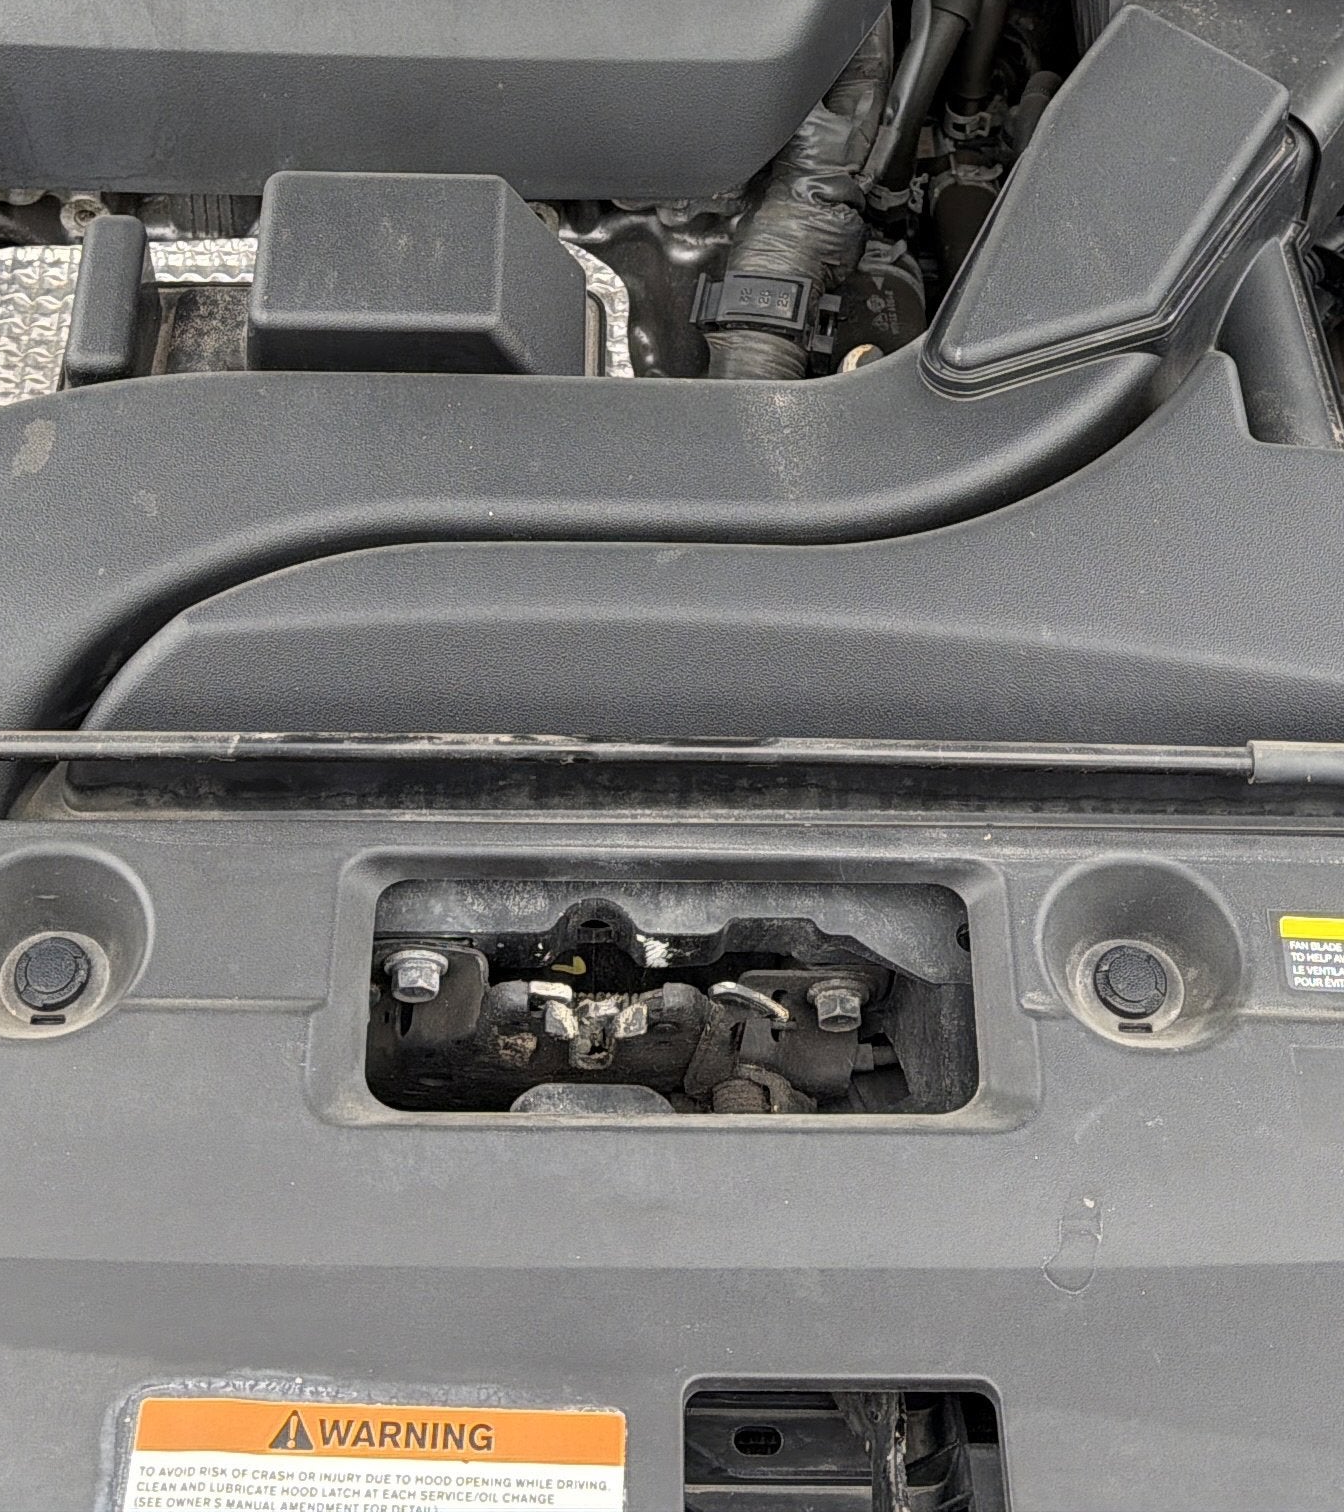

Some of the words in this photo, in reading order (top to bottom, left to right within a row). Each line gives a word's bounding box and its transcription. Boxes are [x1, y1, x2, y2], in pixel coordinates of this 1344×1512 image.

[1289, 940, 1308, 950] FAN
[1311, 942, 1342, 952] BLADE
[1290, 952, 1305, 962] TO
[1307, 954, 1331, 964] HELP
[1293, 965, 1305, 975] LE
[1294, 976, 1323, 987] POUR
[318, 1418, 494, 1451] WARNING
[140, 1466, 155, 1477] TO
[158, 1466, 196, 1478] AVOID
[200, 1466, 227, 1478] RISK
[232, 1468, 248, 1479] OF
[252, 1469, 294, 1480] CRASH
[298, 1471, 315, 1482] OR
[319, 1472, 362, 1482] INJURY
[366, 1474, 391, 1484] DUE
[396, 1474, 411, 1485] TO
[415, 1476, 452, 1486] HOOD
[456, 1476, 512, 1488] OPENING
[516, 1478, 553, 1490] WHILE
[136, 1482, 176, 1492] CLEAN
[180, 1482, 206, 1492] AND
[210, 1482, 276, 1496] LUBRICATE
[280, 1486, 318, 1497] HOOD
[321, 1487, 360, 1498] LATCH
[364, 1490, 380, 1499] AT
[382, 1490, 416, 1500] EACH
[420, 1490, 498, 1503] SERVICE/OIL
[502, 1493, 554, 1504] CHANGE
[133, 1496, 162, 1508] (SEE
[166, 1498, 222, 1509] OWNERS
[226, 1499, 276, 1511] MANUAL
[280, 1500, 360, 1512] AMENDMENT
